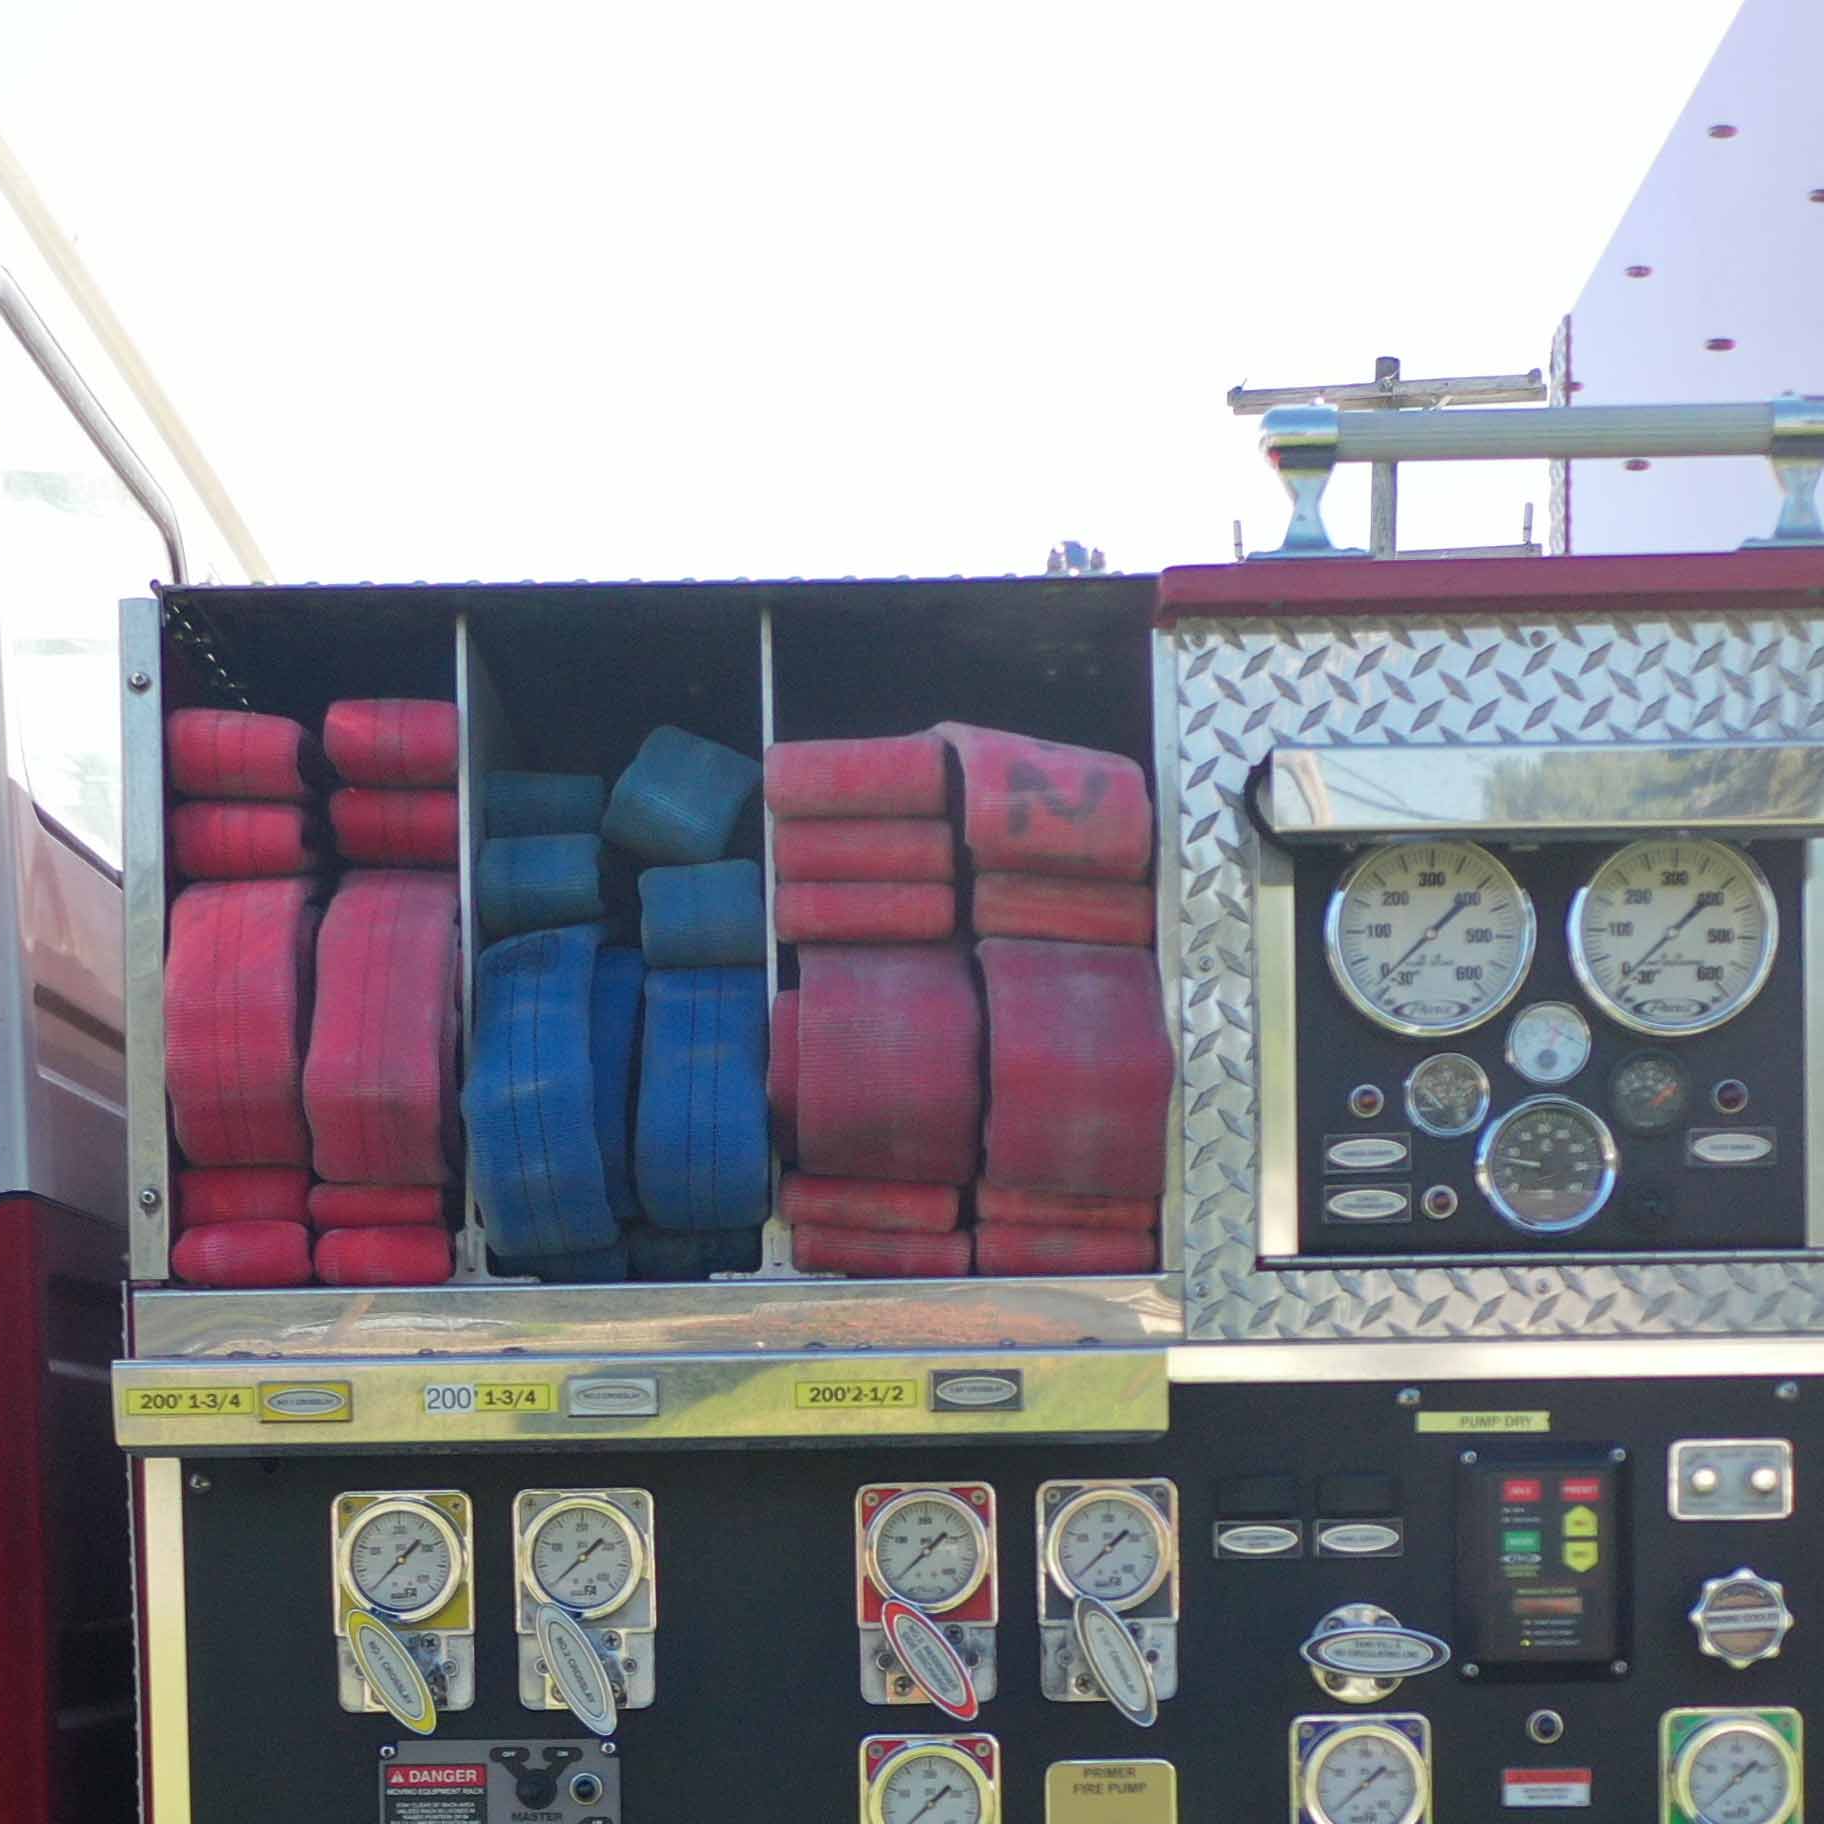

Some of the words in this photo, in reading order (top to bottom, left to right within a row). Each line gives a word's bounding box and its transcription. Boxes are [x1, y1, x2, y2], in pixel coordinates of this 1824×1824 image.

[1381, 891, 1410, 906] 200
[1366, 923, 1392, 938] 100
[1465, 928, 1494, 943] 500
[188, 1392, 241, 1412] 1-3/4
[484, 1389, 537, 1409] 1-3/4
[1459, 1415, 1501, 1429] PUMP
[1503, 1415, 1534, 1429] DRY
[408, 1769, 478, 1784] DANGER
[1082, 1766, 1137, 1779] PRIMER
[418, 1787, 461, 1796] EQUIPMENT
[1072, 1783, 1104, 1796] FIRE
[1107, 1782, 1147, 1794] PUMP
[511, 1812, 563, 1822] MASTER
